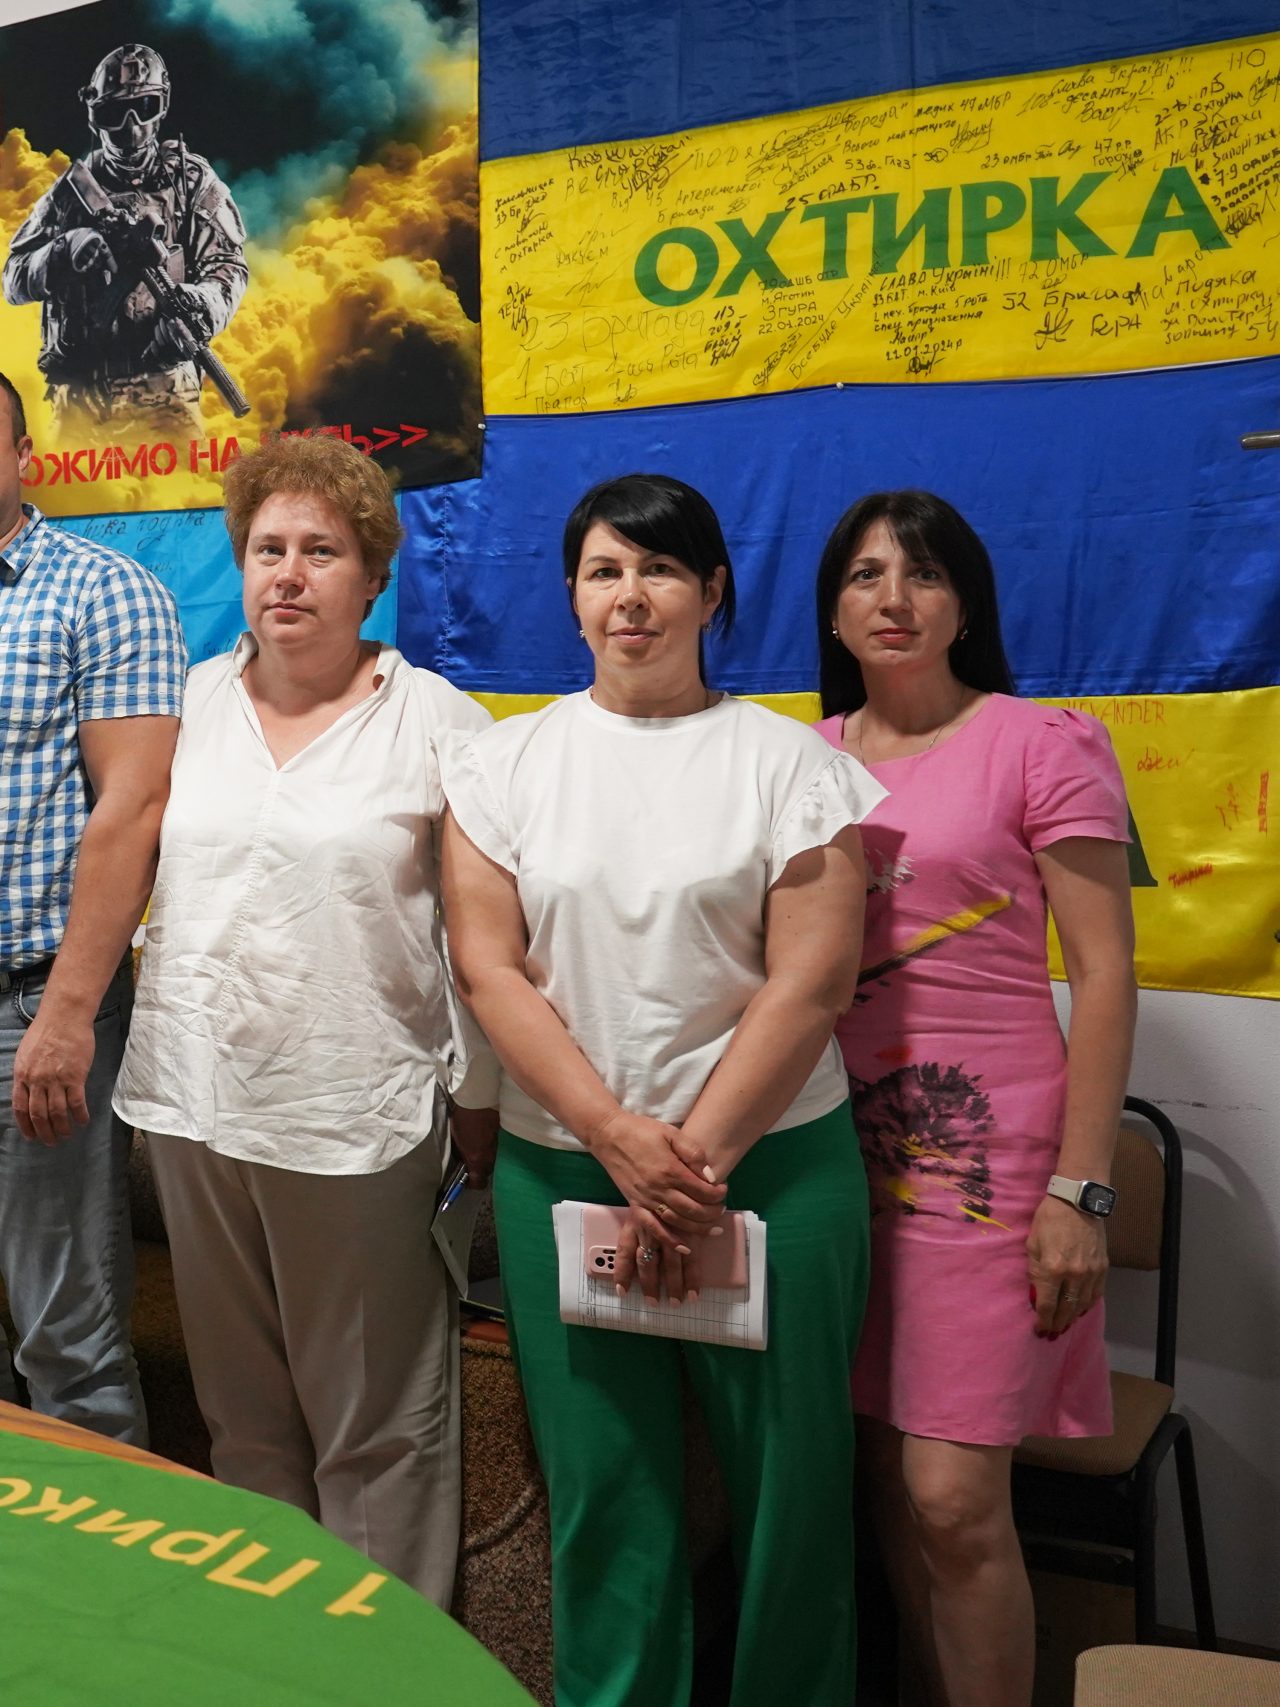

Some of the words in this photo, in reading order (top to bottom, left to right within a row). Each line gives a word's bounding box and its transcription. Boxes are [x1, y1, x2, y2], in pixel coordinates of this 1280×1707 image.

[633, 165, 1233, 308] ОХТИРКА
[189, 437, 242, 474] НА
[324, 1572, 388, 1617] 1
